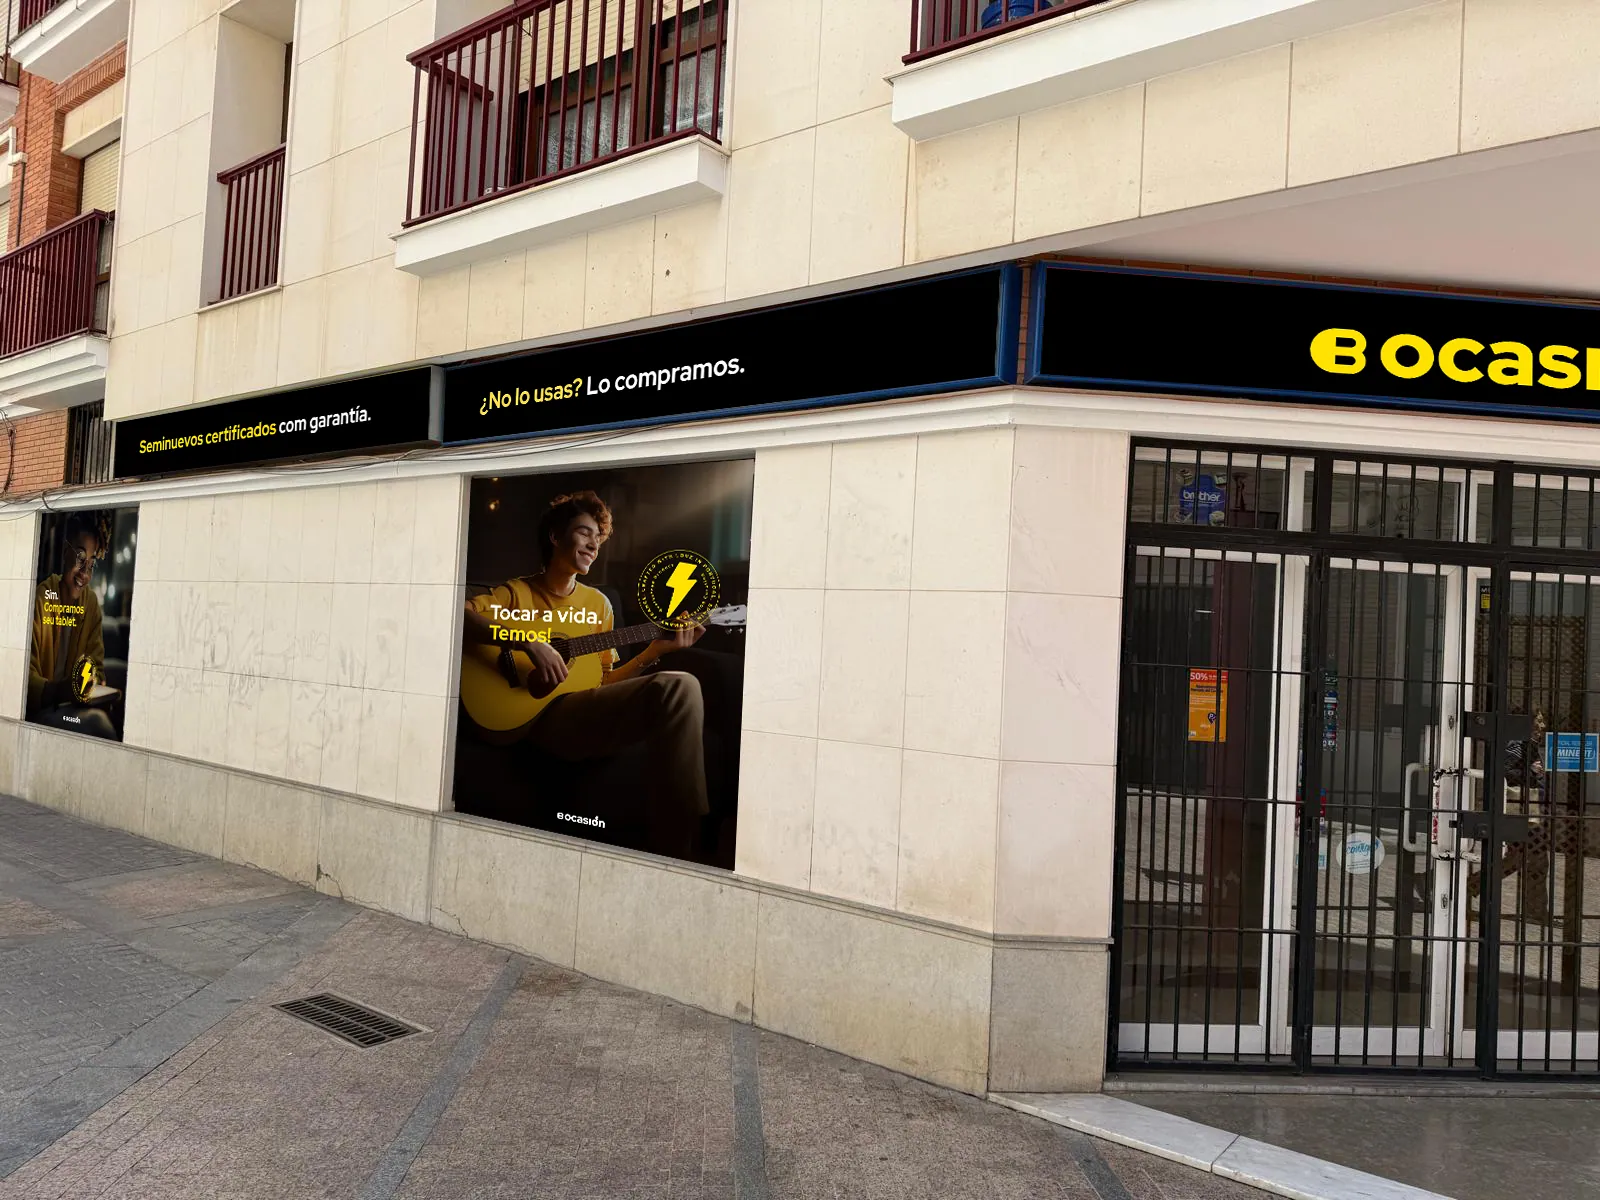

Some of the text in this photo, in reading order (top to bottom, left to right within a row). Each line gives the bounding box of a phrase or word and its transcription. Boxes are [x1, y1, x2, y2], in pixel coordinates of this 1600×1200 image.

[479, 358, 745, 416] ¿No lo usas? Lo compramos.
[139, 406, 372, 454] Seminuevos certificados com garantía.
[1183, 489, 1221, 502] brther
[44, 589, 59, 600] Sim.
[43, 602, 85, 615] Compramos
[490, 604, 603, 625] Tocar a vida.
[42, 615, 77, 627] seu tablet.
[489, 624, 552, 644] Temos!
[1190, 672, 1209, 681] 50%
[564, 813, 606, 829] ocasión
